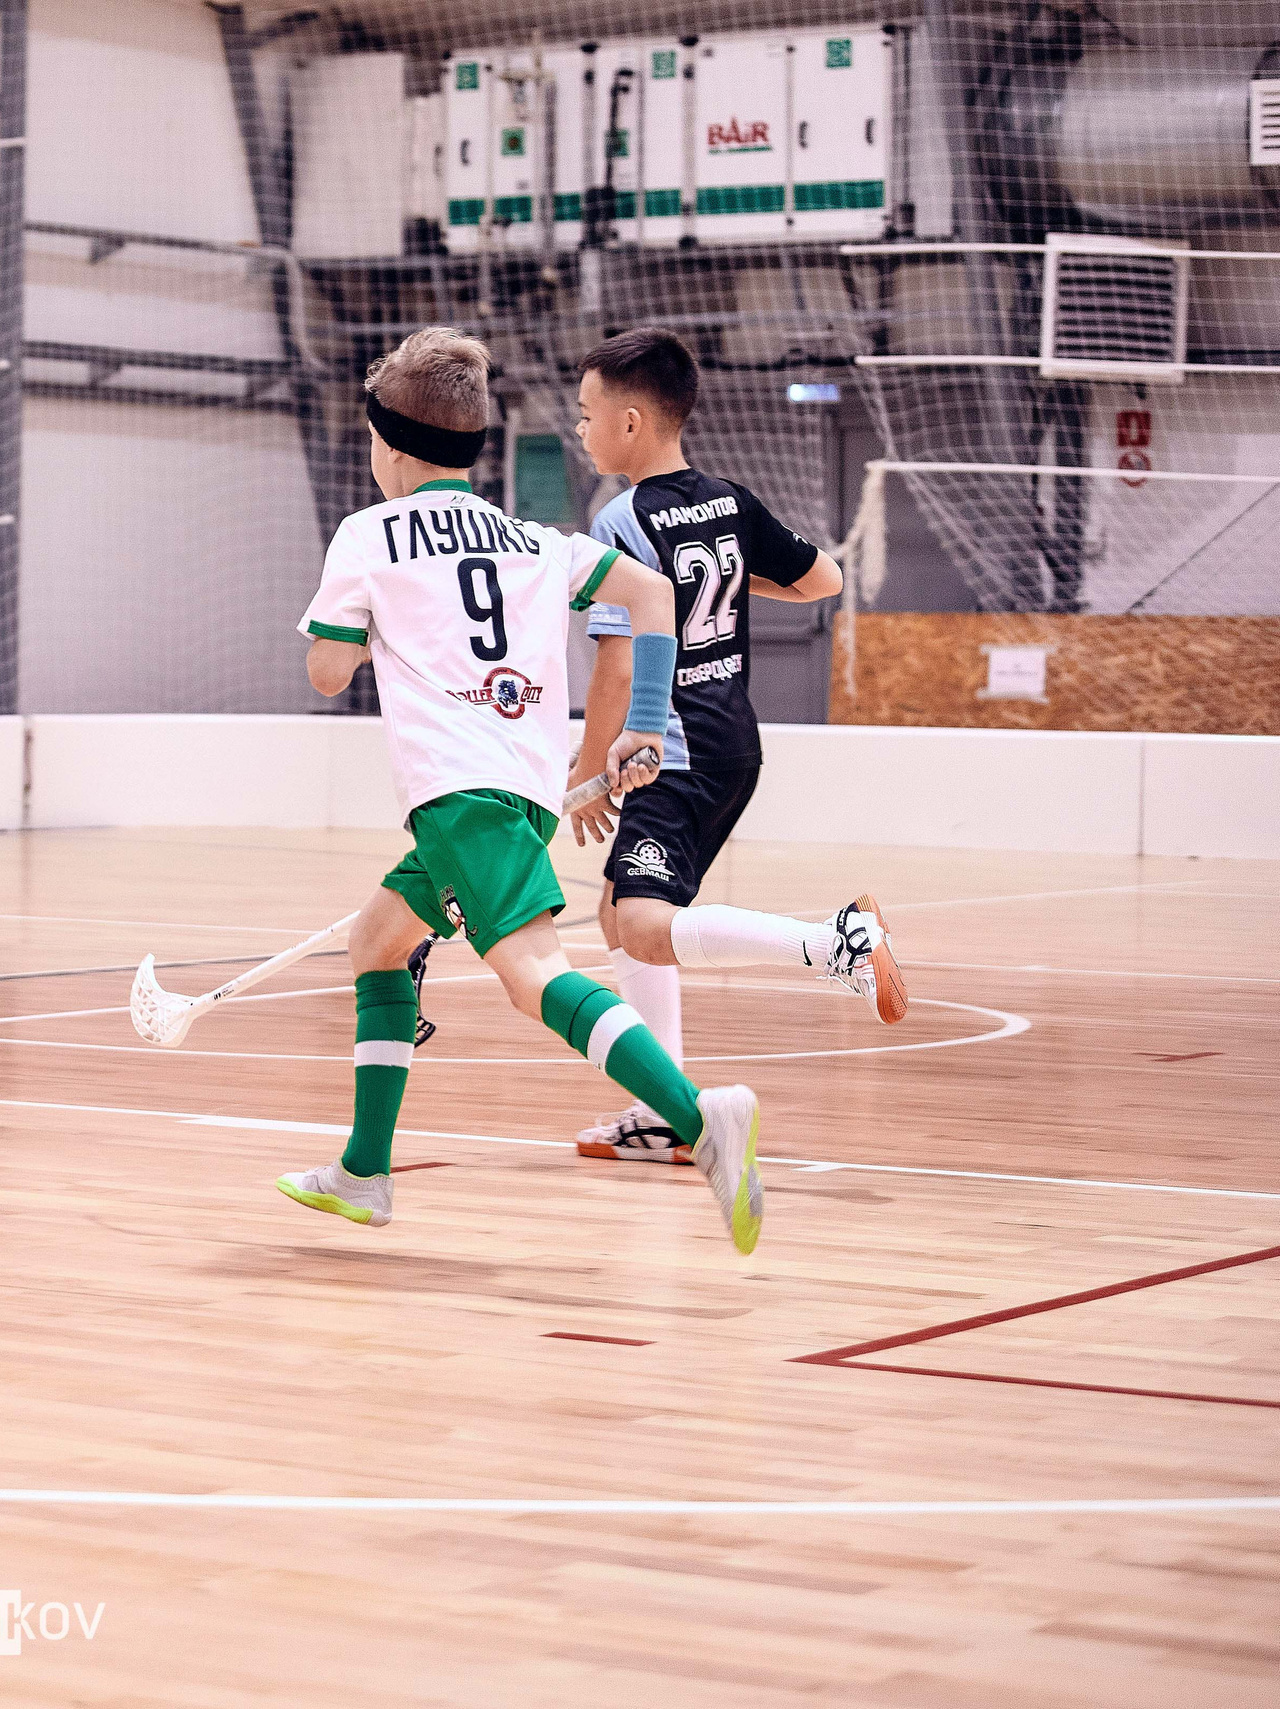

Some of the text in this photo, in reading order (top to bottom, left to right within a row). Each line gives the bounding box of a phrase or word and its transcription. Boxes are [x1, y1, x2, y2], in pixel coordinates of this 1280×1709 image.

[649, 496, 738, 531] МАМОНТОВ
[456, 558, 508, 662] 9
[673, 534, 744, 650] 22
